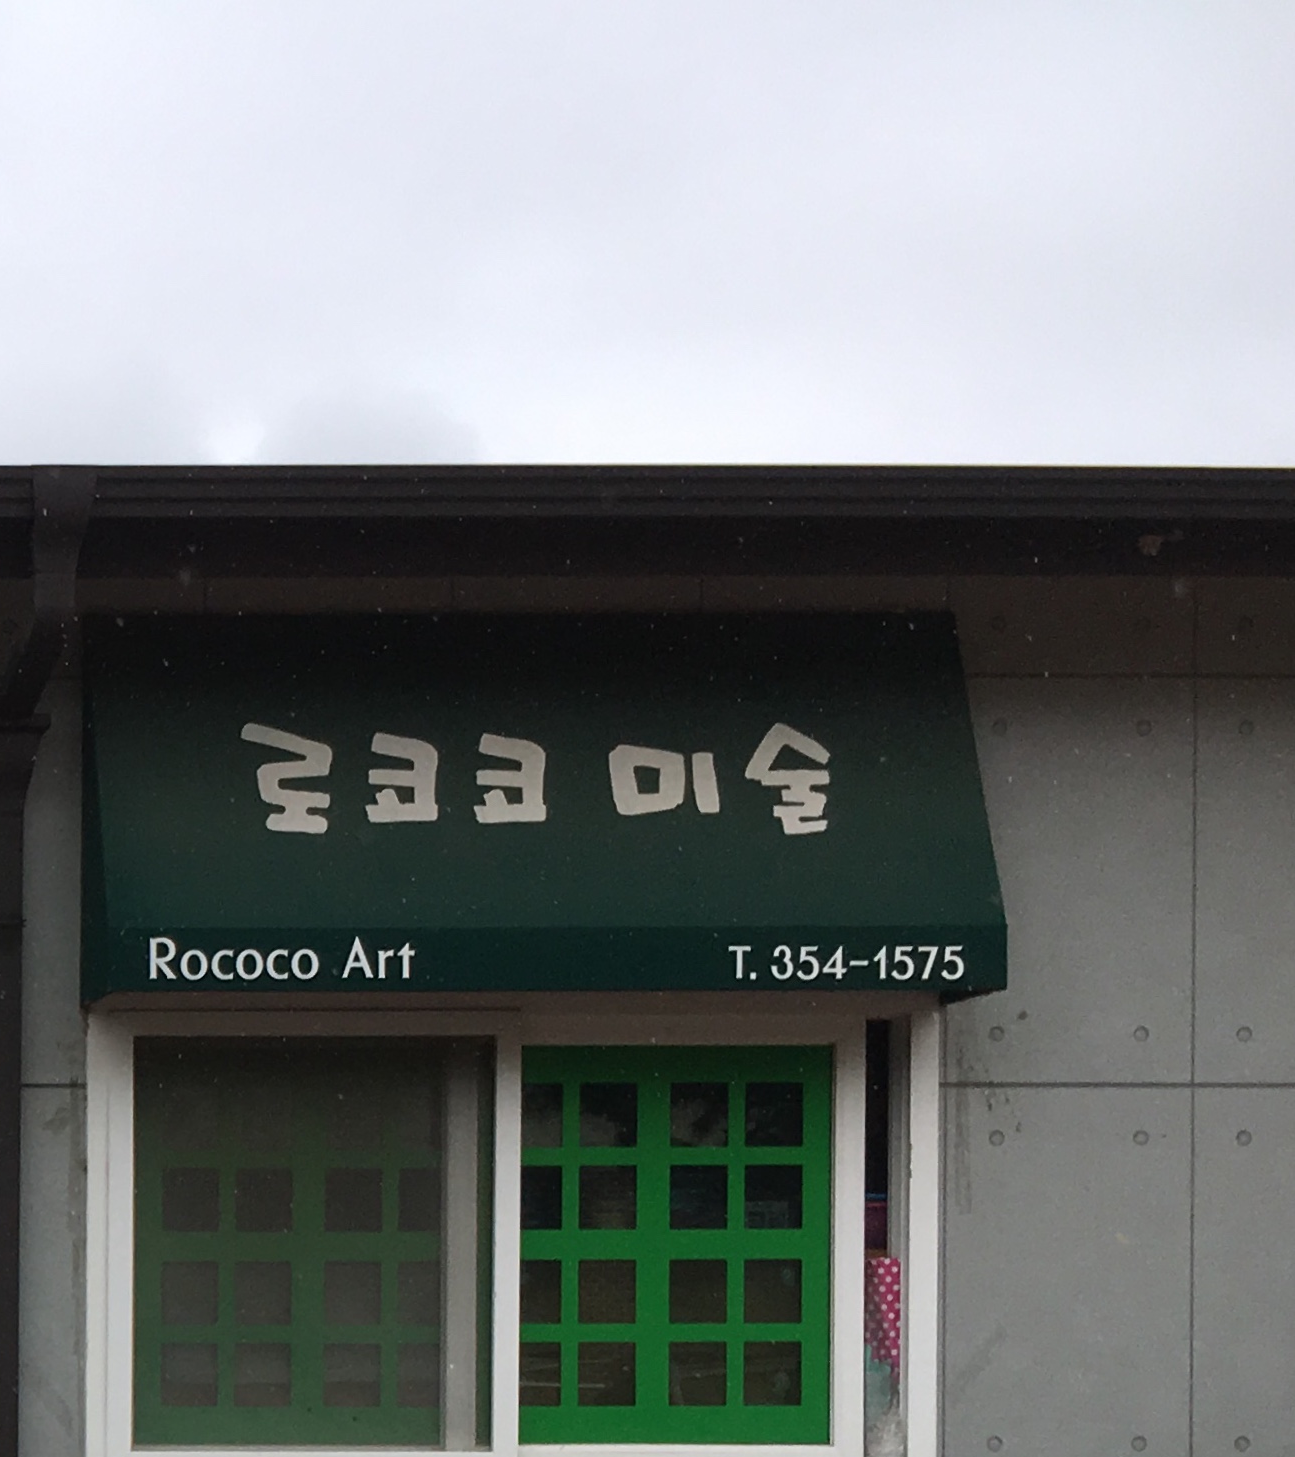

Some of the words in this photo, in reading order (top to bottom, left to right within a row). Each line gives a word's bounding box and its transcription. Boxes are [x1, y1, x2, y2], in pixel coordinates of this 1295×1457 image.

[241, 723, 547, 835] 로코코
[608, 722, 831, 836] 미술
[149, 936, 320, 981] Rococo
[341, 936, 416, 980] Art
[728, 945, 757, 980] T.
[770, 944, 965, 981] 354-1575
